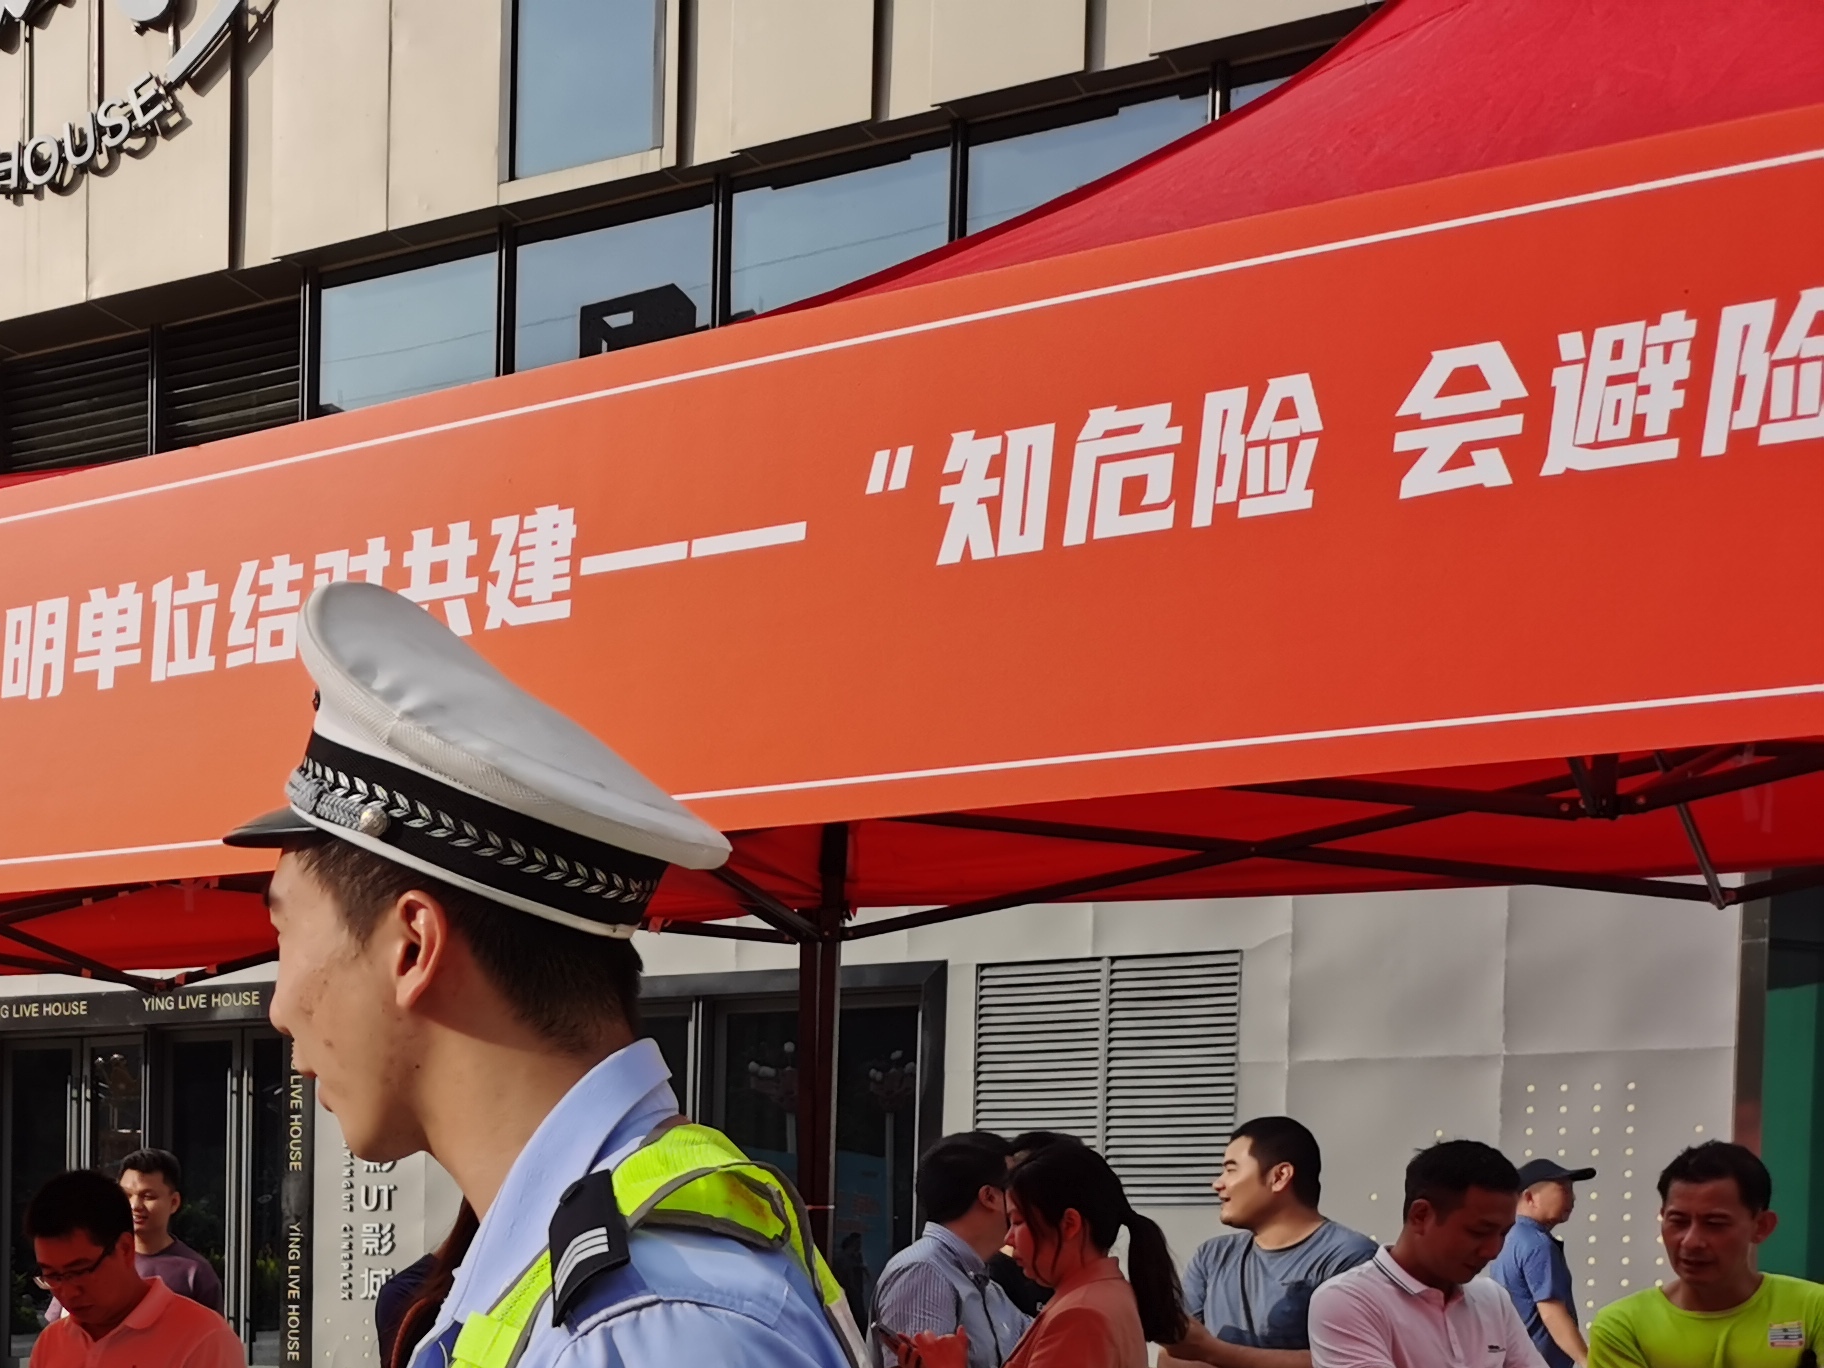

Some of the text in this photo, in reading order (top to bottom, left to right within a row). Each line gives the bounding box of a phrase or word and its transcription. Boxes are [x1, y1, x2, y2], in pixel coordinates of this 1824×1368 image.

[12, 1003, 39, 1017] LIVE
[43, 1001, 88, 1016] HOUSE
[178, 993, 207, 1009] LIVE
[211, 991, 260, 1007] HOUSE
[290, 1075, 303, 1109] LIVE
[289, 1114, 303, 1171] HOUSE
[340, 1224, 354, 1301] CINEPLEX
[288, 1265, 301, 1300] LIVE
[287, 1304, 301, 1362] HOUSE
